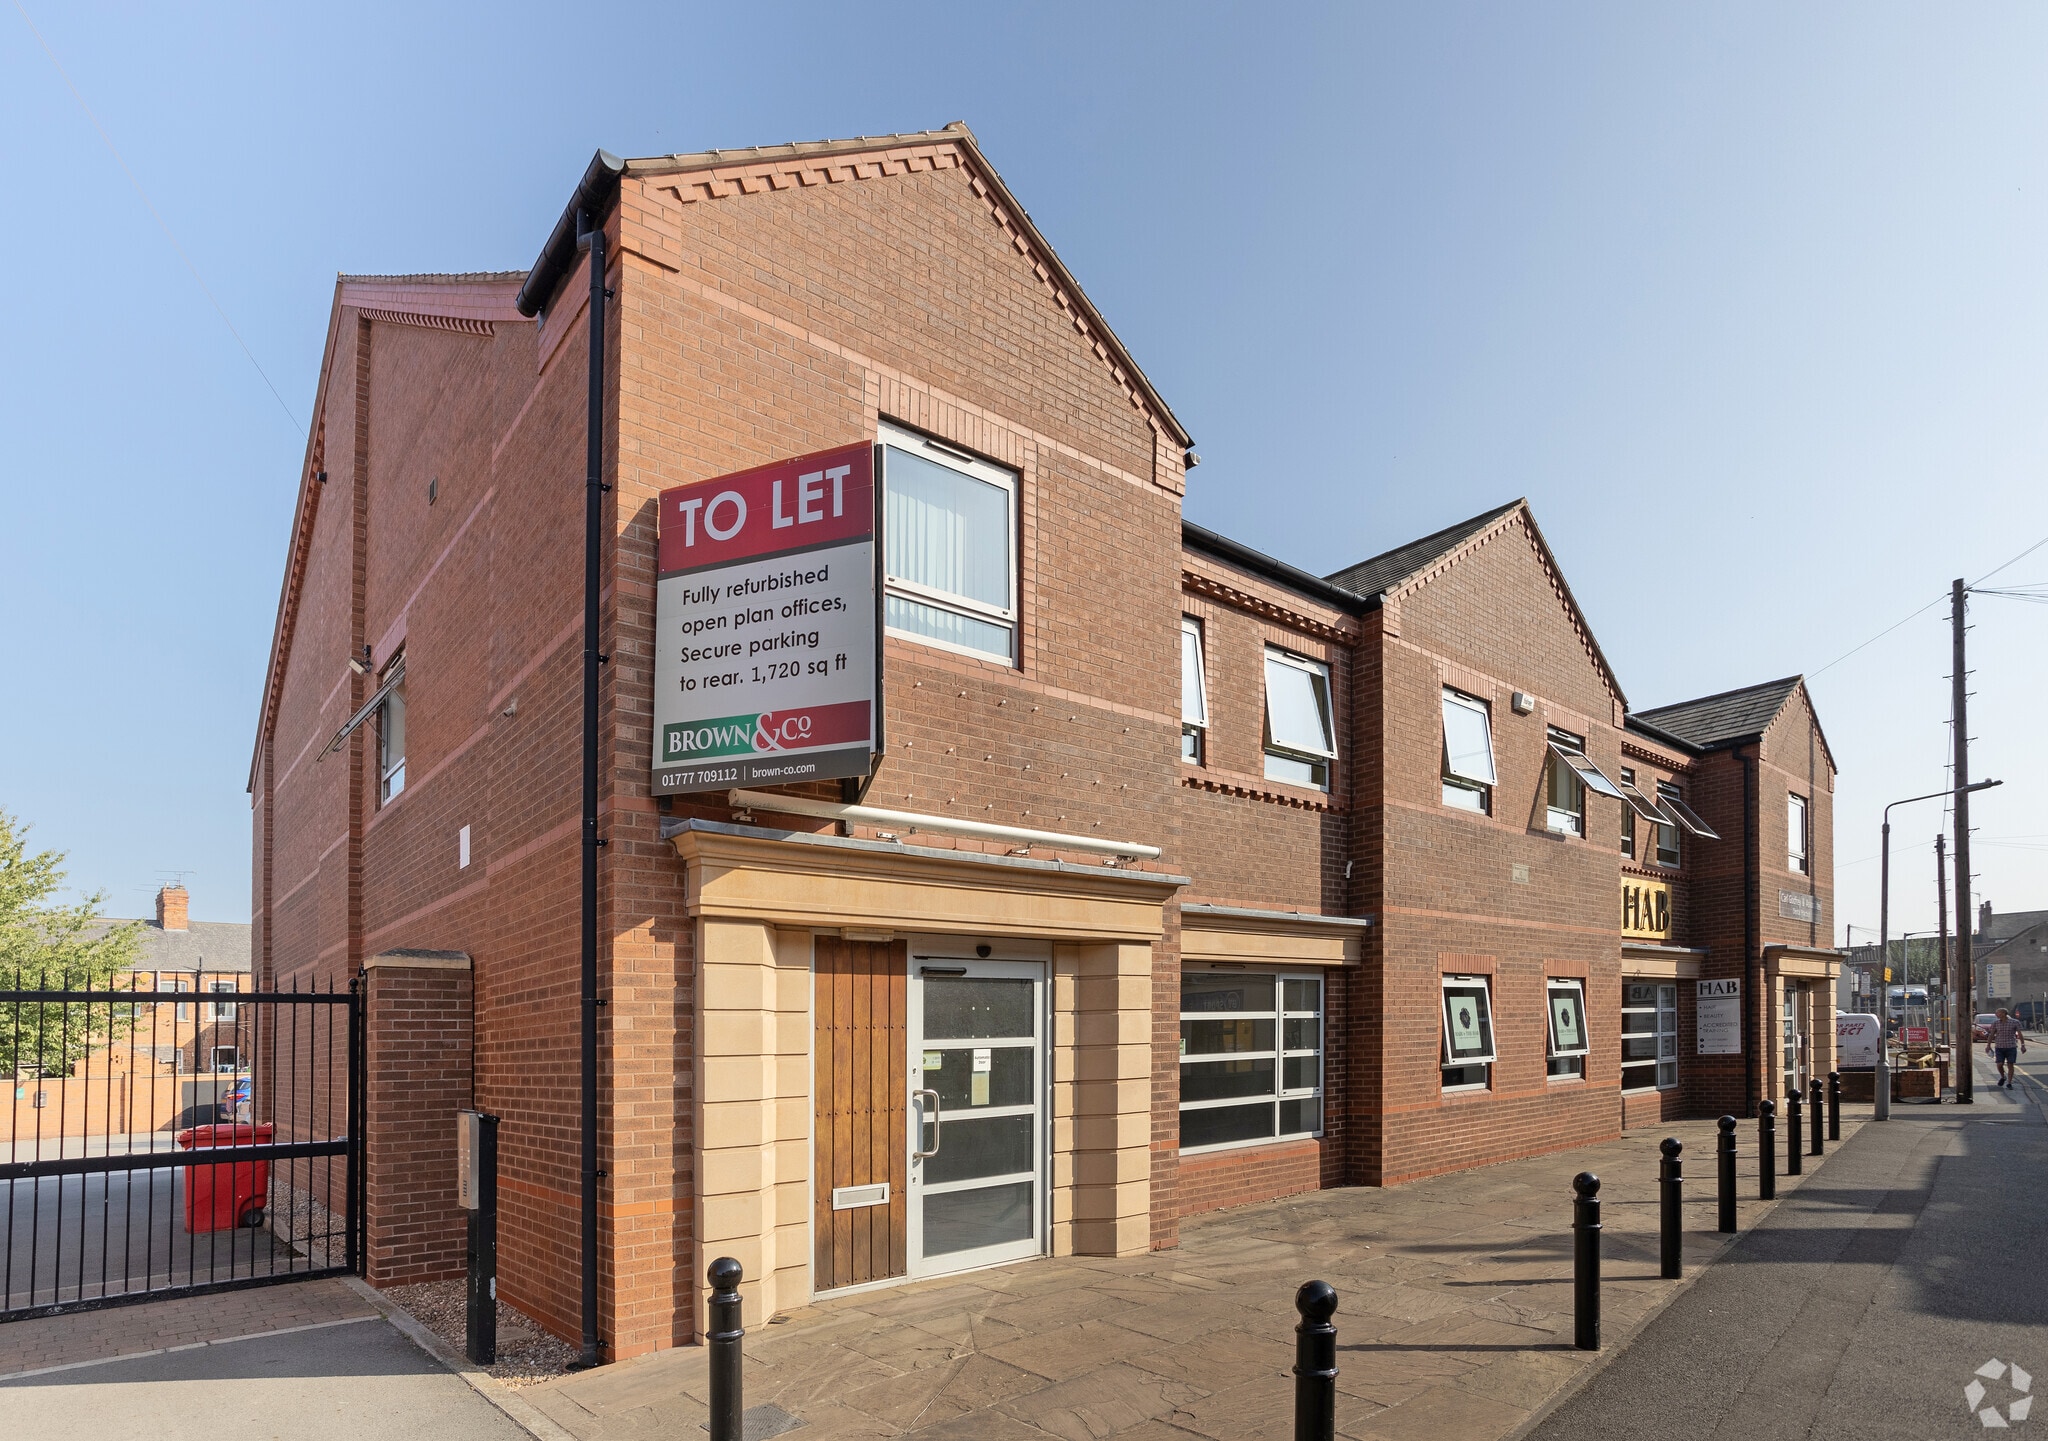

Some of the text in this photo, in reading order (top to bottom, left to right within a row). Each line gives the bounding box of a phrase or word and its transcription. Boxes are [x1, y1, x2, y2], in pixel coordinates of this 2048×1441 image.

[679, 464, 850, 547] TO LET
[683, 565, 828, 609] Fully refurbished
[682, 596, 847, 638] open plan offices,
[681, 630, 819, 663] Secure parking
[680, 654, 847, 692] to rear. 1,720 sq ft
[662, 763, 816, 787] 01777 709112 brown-co.com
[1623, 885, 1669, 932] HAB
[1699, 981, 1737, 995] HAB
